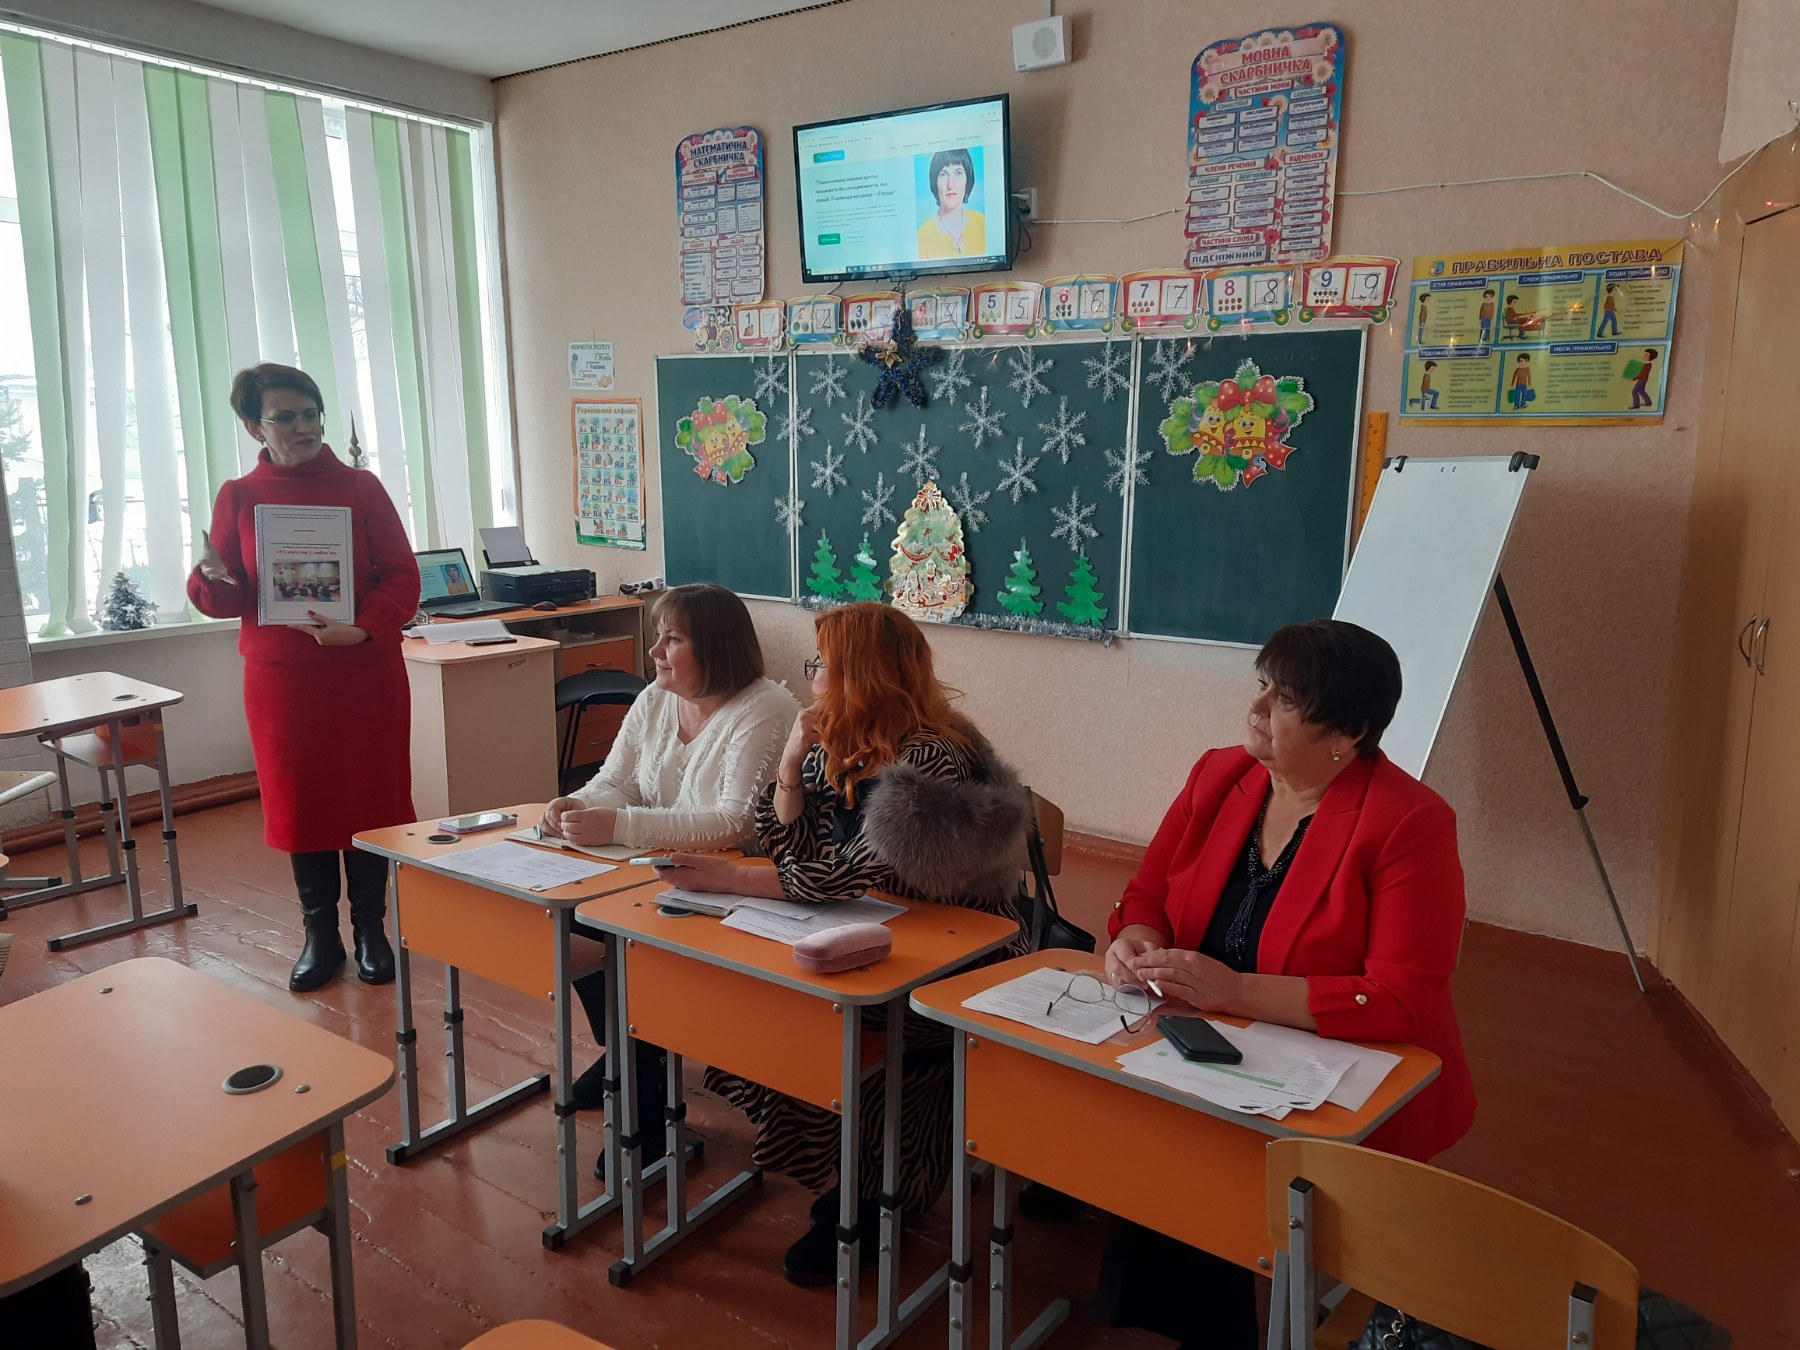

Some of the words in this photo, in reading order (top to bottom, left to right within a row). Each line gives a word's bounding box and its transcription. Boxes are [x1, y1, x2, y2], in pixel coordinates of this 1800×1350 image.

[1242, 46, 1291, 64] МОВНА
[1220, 59, 1312, 84] СКАРБНИЧКА
[1238, 85, 1269, 95] ЧАСТИНИ
[1270, 81, 1291, 90] МОВИ
[690, 141, 747, 158] МАТЕМАТИЧНА
[693, 152, 745, 168] СКАРБНИЧКА
[1202, 237, 1231, 246] ЧАСТИНИ
[1232, 235, 1254, 243] СЛОВА
[1192, 251, 1262, 263] ПІДСНІЖНИКИ
[1452, 254, 1563, 275] ПРАВИЛЬНА
[1568, 248, 1662, 266] ПОСТАВА
[1321, 271, 1333, 287] 9
[1541, 273, 1578, 281] ПРАВИЛЬНО
[1627, 268, 1668, 276] ПРАВИЛНО
[1140, 283, 1150, 299] 7
[1224, 280, 1235, 296] 8
[1263, 279, 1278, 304] 8
[1360, 272, 1380, 300] 9
[987, 294, 996, 309] 5
[1060, 287, 1068, 303] 6
[1091, 290, 1104, 313] 6
[1173, 285, 1188, 308] 7
[798, 307, 806, 319] 2
[856, 304, 863, 318] 3
[1014, 297, 1029, 319] 5
[745, 312, 751, 324] 1
[821, 308, 833, 328] 2
[577, 406, 612, 414] Український
